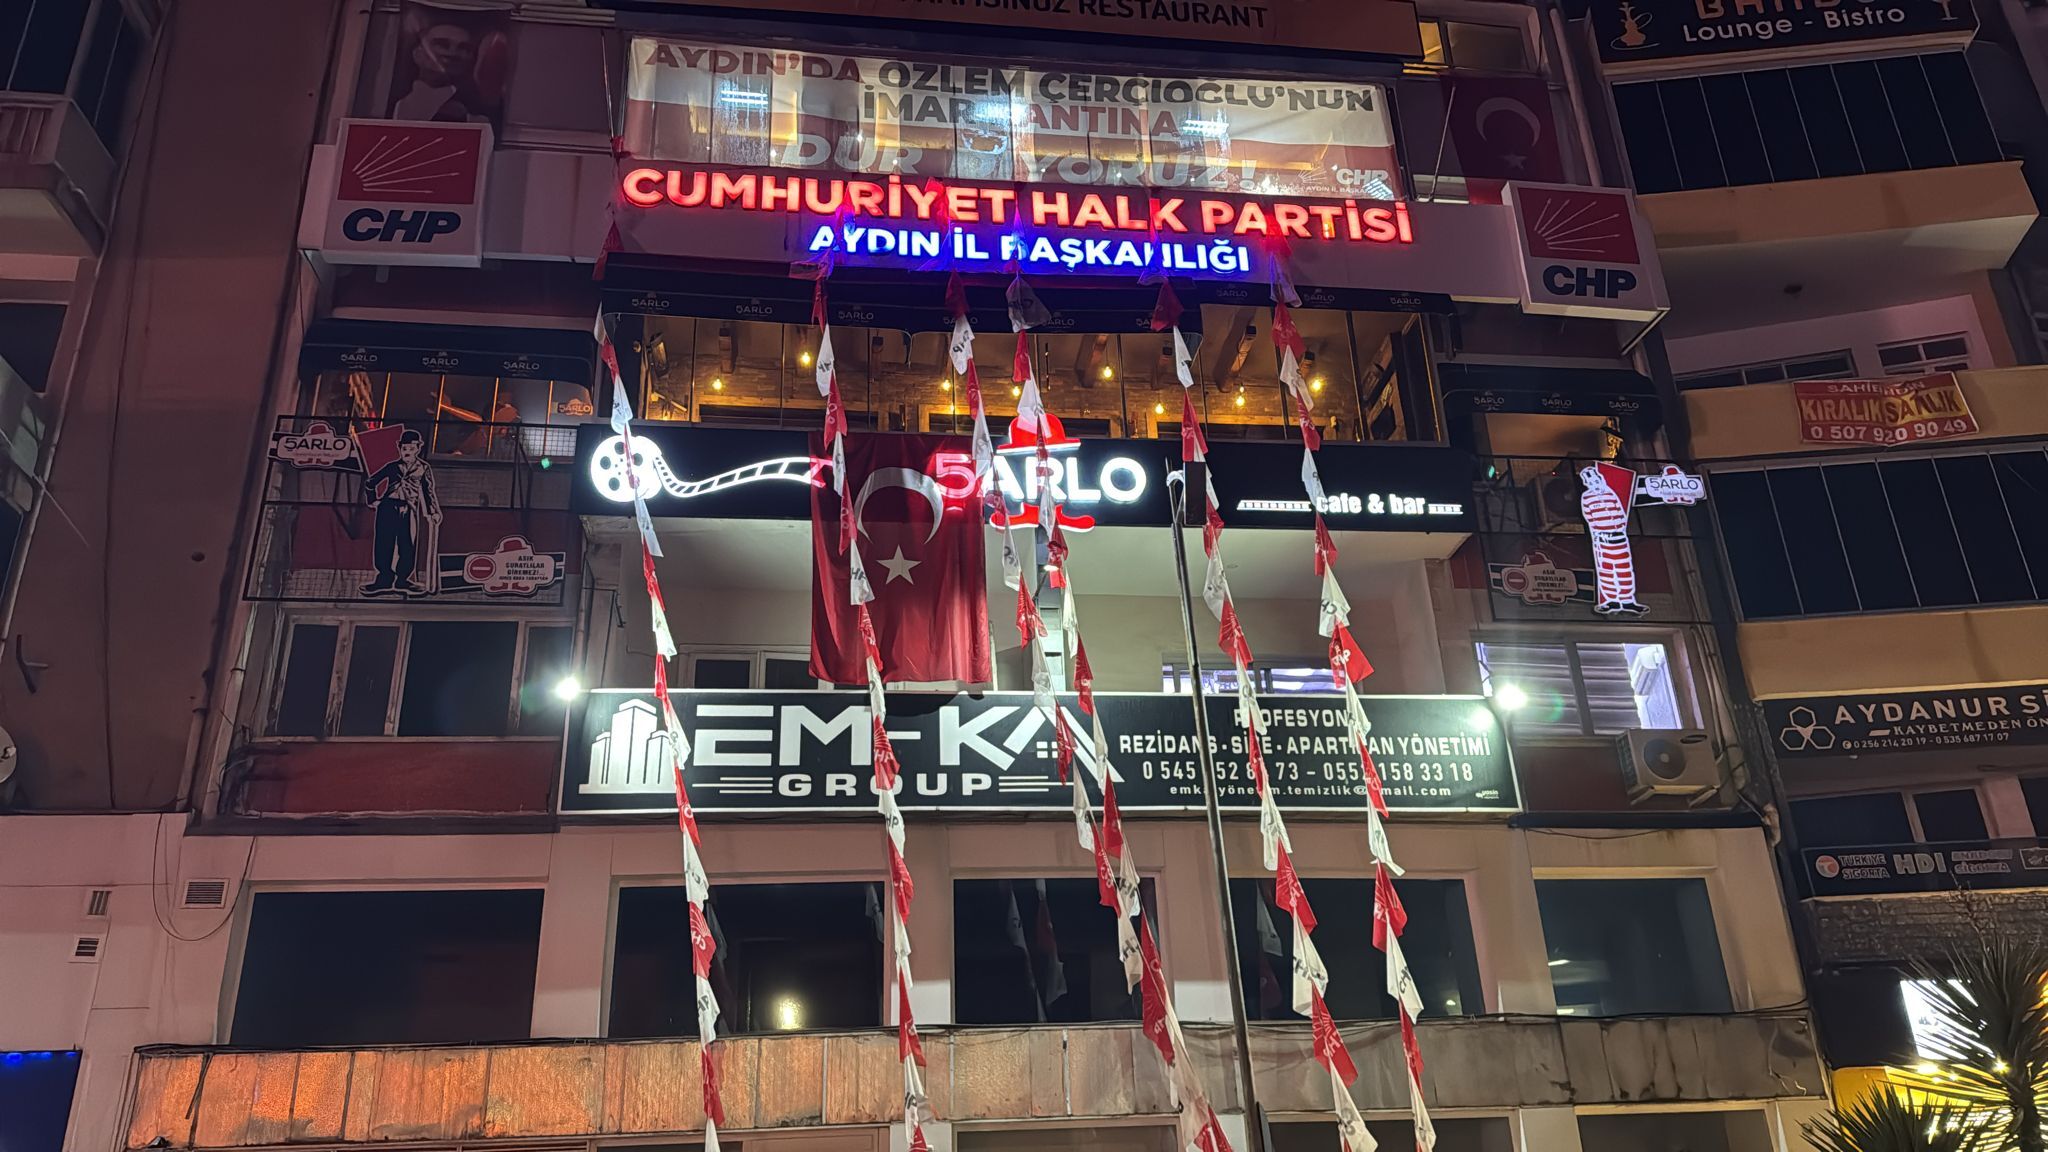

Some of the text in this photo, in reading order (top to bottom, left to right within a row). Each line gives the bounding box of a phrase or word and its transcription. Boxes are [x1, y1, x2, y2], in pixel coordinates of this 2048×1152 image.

[1079, 0, 1268, 28] RESTAURANT
[1683, 15, 1793, 42] Lounge
[1825, 5, 1905, 29] Bistro
[1012, 102, 1182, 137] ANTINA
[780, 133, 925, 175] DUR
[622, 168, 1414, 245] CUMHURİYET HALK PARTİSİ
[342, 208, 462, 243] CHP
[808, 225, 941, 258] AYDIN
[952, 226, 990, 260] İL
[1542, 265, 1638, 300] CHP
[1800, 399, 1884, 422] KIRALIK
[1811, 419, 1967, 442] 0 507 920 90 49
[1316, 493, 1425, 515] cafe & bar
[1234, 709, 1349, 727] POFESYON
[1834, 695, 2012, 726] AYDANUR
[1893, 717, 2022, 737] KAYBETMEDEN
[1231, 731, 1273, 755] SİE
[1287, 736, 1395, 756] APARTAN
[1397, 731, 1491, 756] YÖNETİMİ
[1862, 739, 1880, 749] 256
[1881, 737, 1899, 748] 214
[1900, 737, 1914, 747] 20
[1142, 761, 1153, 780] 0
[1160, 761, 1196, 780] 545
[1276, 762, 1299, 780] 73
[1379, 762, 1414, 781] 158
[1420, 762, 1444, 781] 33
[1450, 762, 1473, 781] 18
[1893, 852, 1947, 876] HDI
